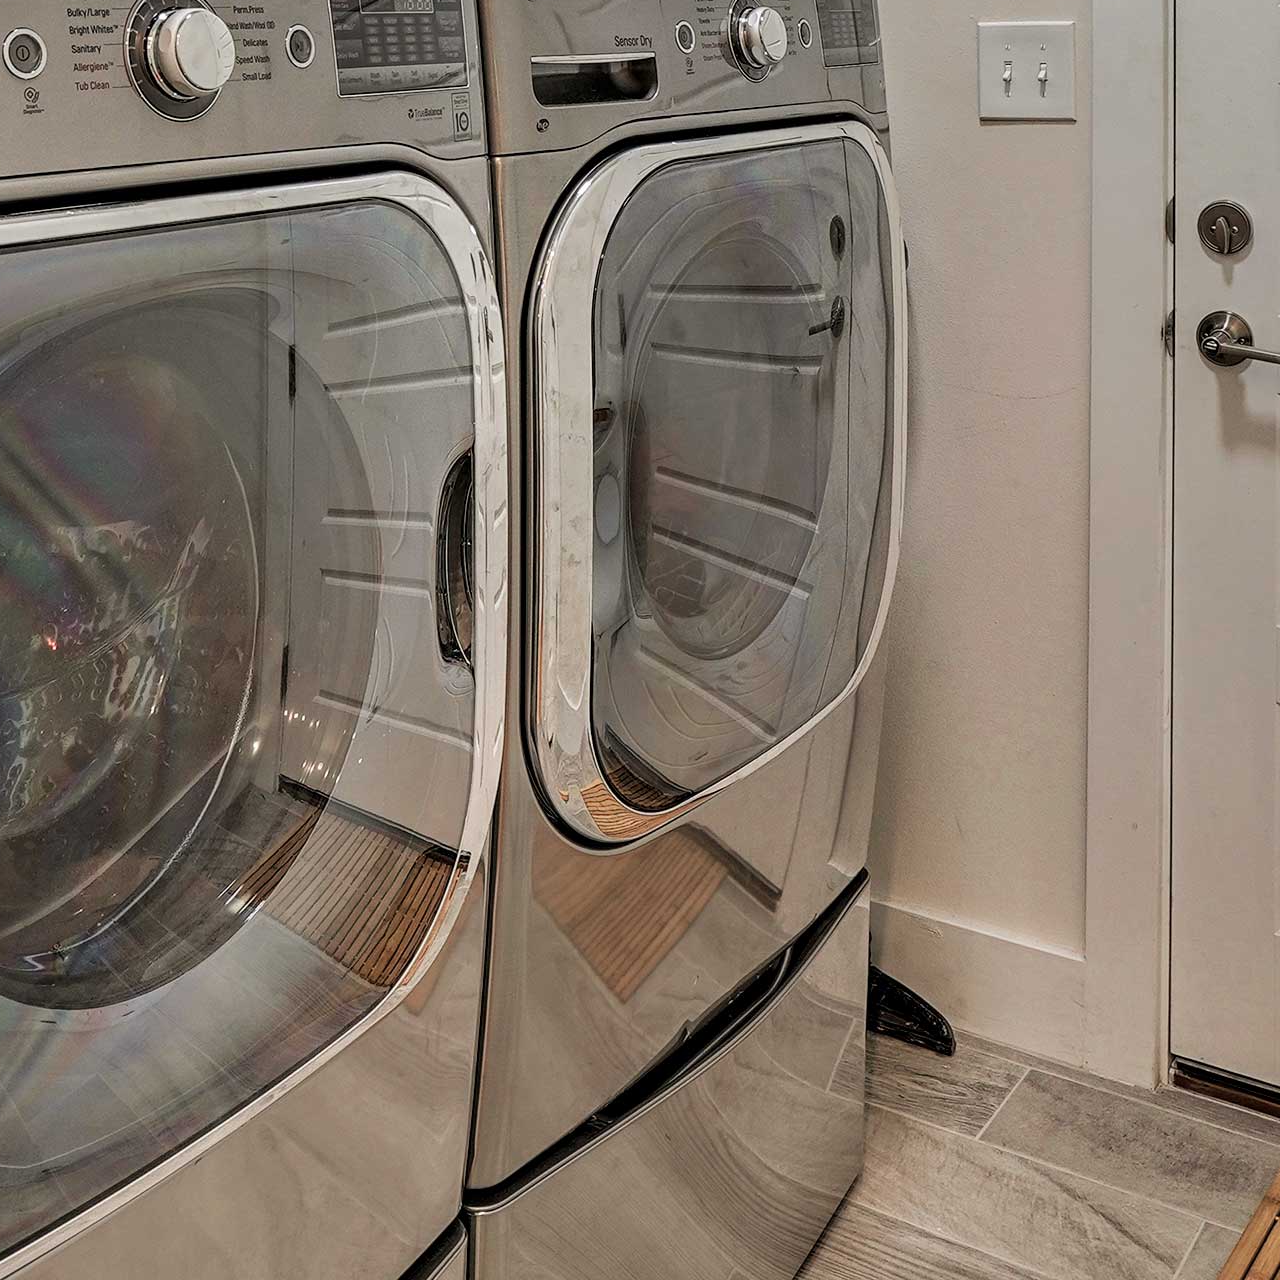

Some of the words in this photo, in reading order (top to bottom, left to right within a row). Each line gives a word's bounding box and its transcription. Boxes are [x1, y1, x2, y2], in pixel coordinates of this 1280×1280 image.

[66, 7, 111, 18] Bulky/Large
[68, 25, 90, 36] Bright
[242, 38, 269, 47] Delicates
[614, 35, 639, 47] Sensor
[639, 34, 653, 48] Dry
[71, 44, 102, 54] Sanitary
[253, 55, 271, 63] Wash
[241, 72, 258, 81] Small
[258, 71, 272, 81] Load
[74, 81, 89, 91] Tub
[89, 81, 110, 90] Clean
